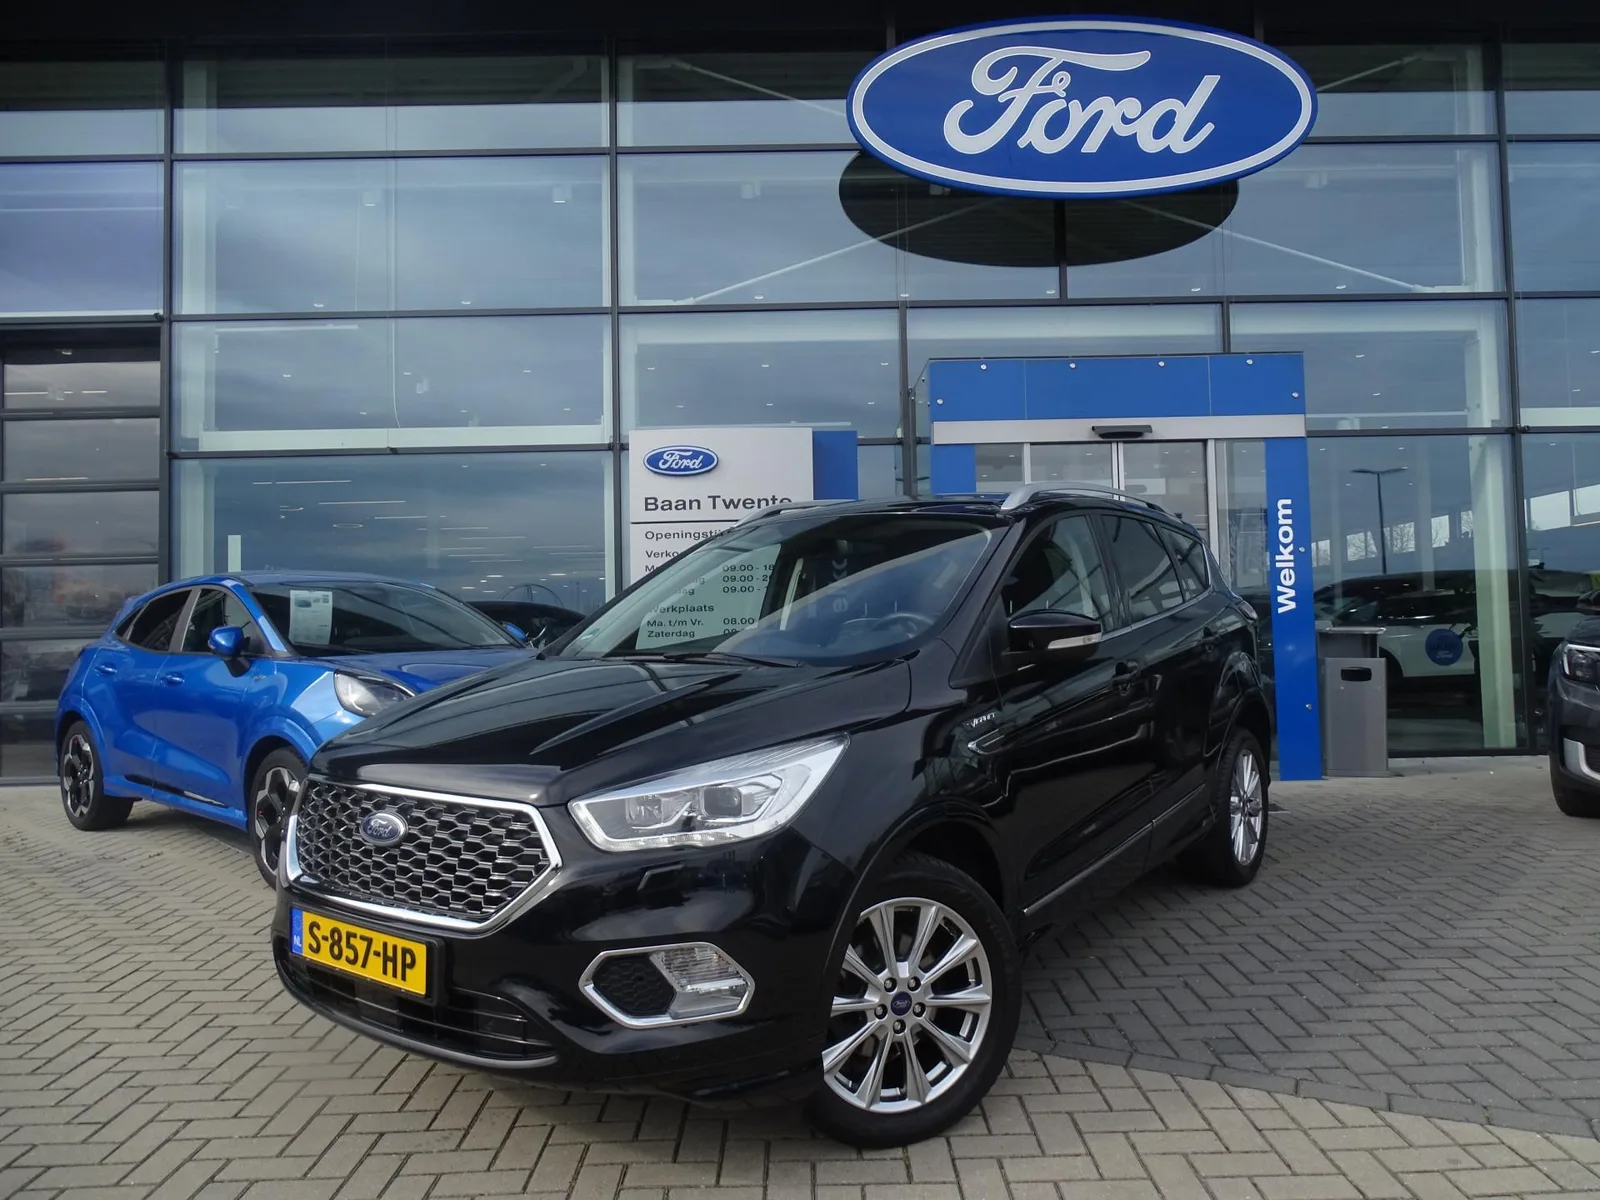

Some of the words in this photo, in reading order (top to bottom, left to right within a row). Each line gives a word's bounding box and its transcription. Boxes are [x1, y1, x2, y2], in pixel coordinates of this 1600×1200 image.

[943, 45, 1221, 155] Ford
[658, 450, 704, 469] Ford
[644, 496, 701, 512] Baan
[645, 549, 679, 559] Verko
[1275, 498, 1297, 614] Welkom
[722, 564, 754, 572] 09.00
[763, 564, 775, 572] 18
[722, 574, 754, 583] 09.00
[722, 585, 755, 594] 09.00
[668, 619, 688, 627] t/m
[690, 618, 704, 627] Vr.
[723, 617, 755, 625] 08.00
[647, 630, 696, 639] Zaterdag
[367, 818, 393, 837] Ford
[293, 934, 302, 948] NL
[308, 920, 417, 982] S-857-HP
